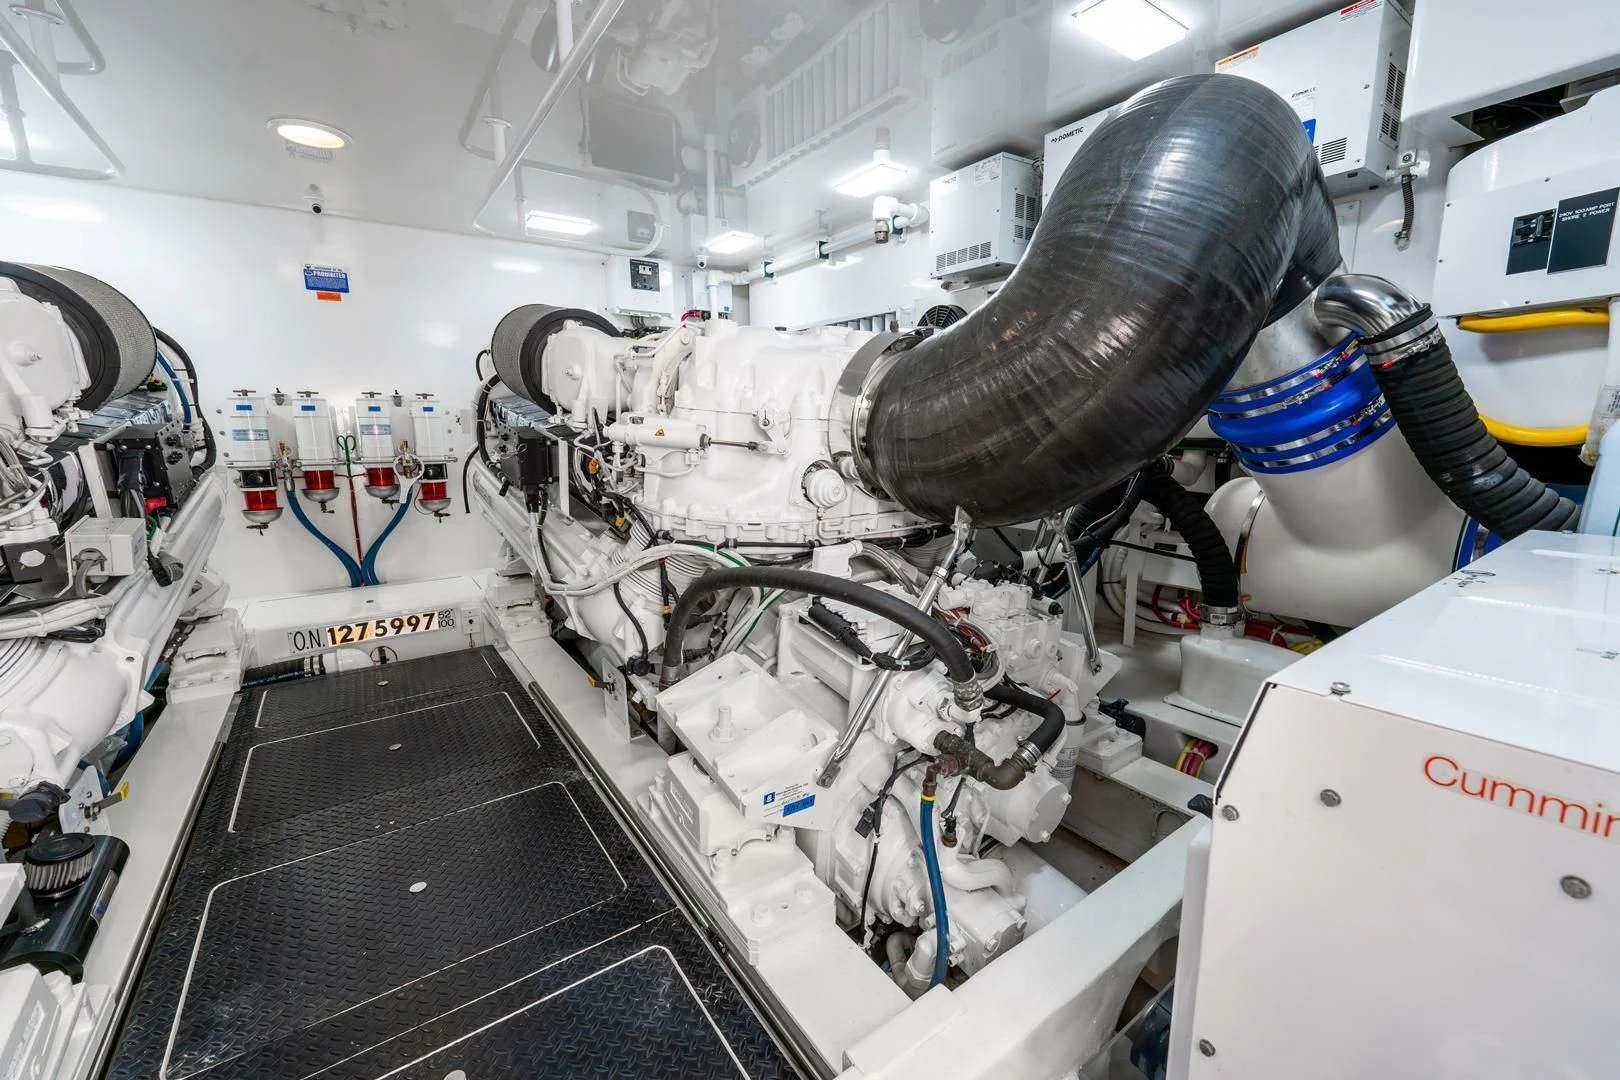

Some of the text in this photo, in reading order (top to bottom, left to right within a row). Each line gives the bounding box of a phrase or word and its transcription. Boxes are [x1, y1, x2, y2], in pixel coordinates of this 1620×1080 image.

[1058, 126, 1084, 142] DOMETIC
[1599, 201, 1615, 209] PORT
[1589, 208, 1610, 216] POWER
[438, 609, 451, 619] 52
[437, 618, 454, 629] 100
[293, 629, 326, 651] O.N.
